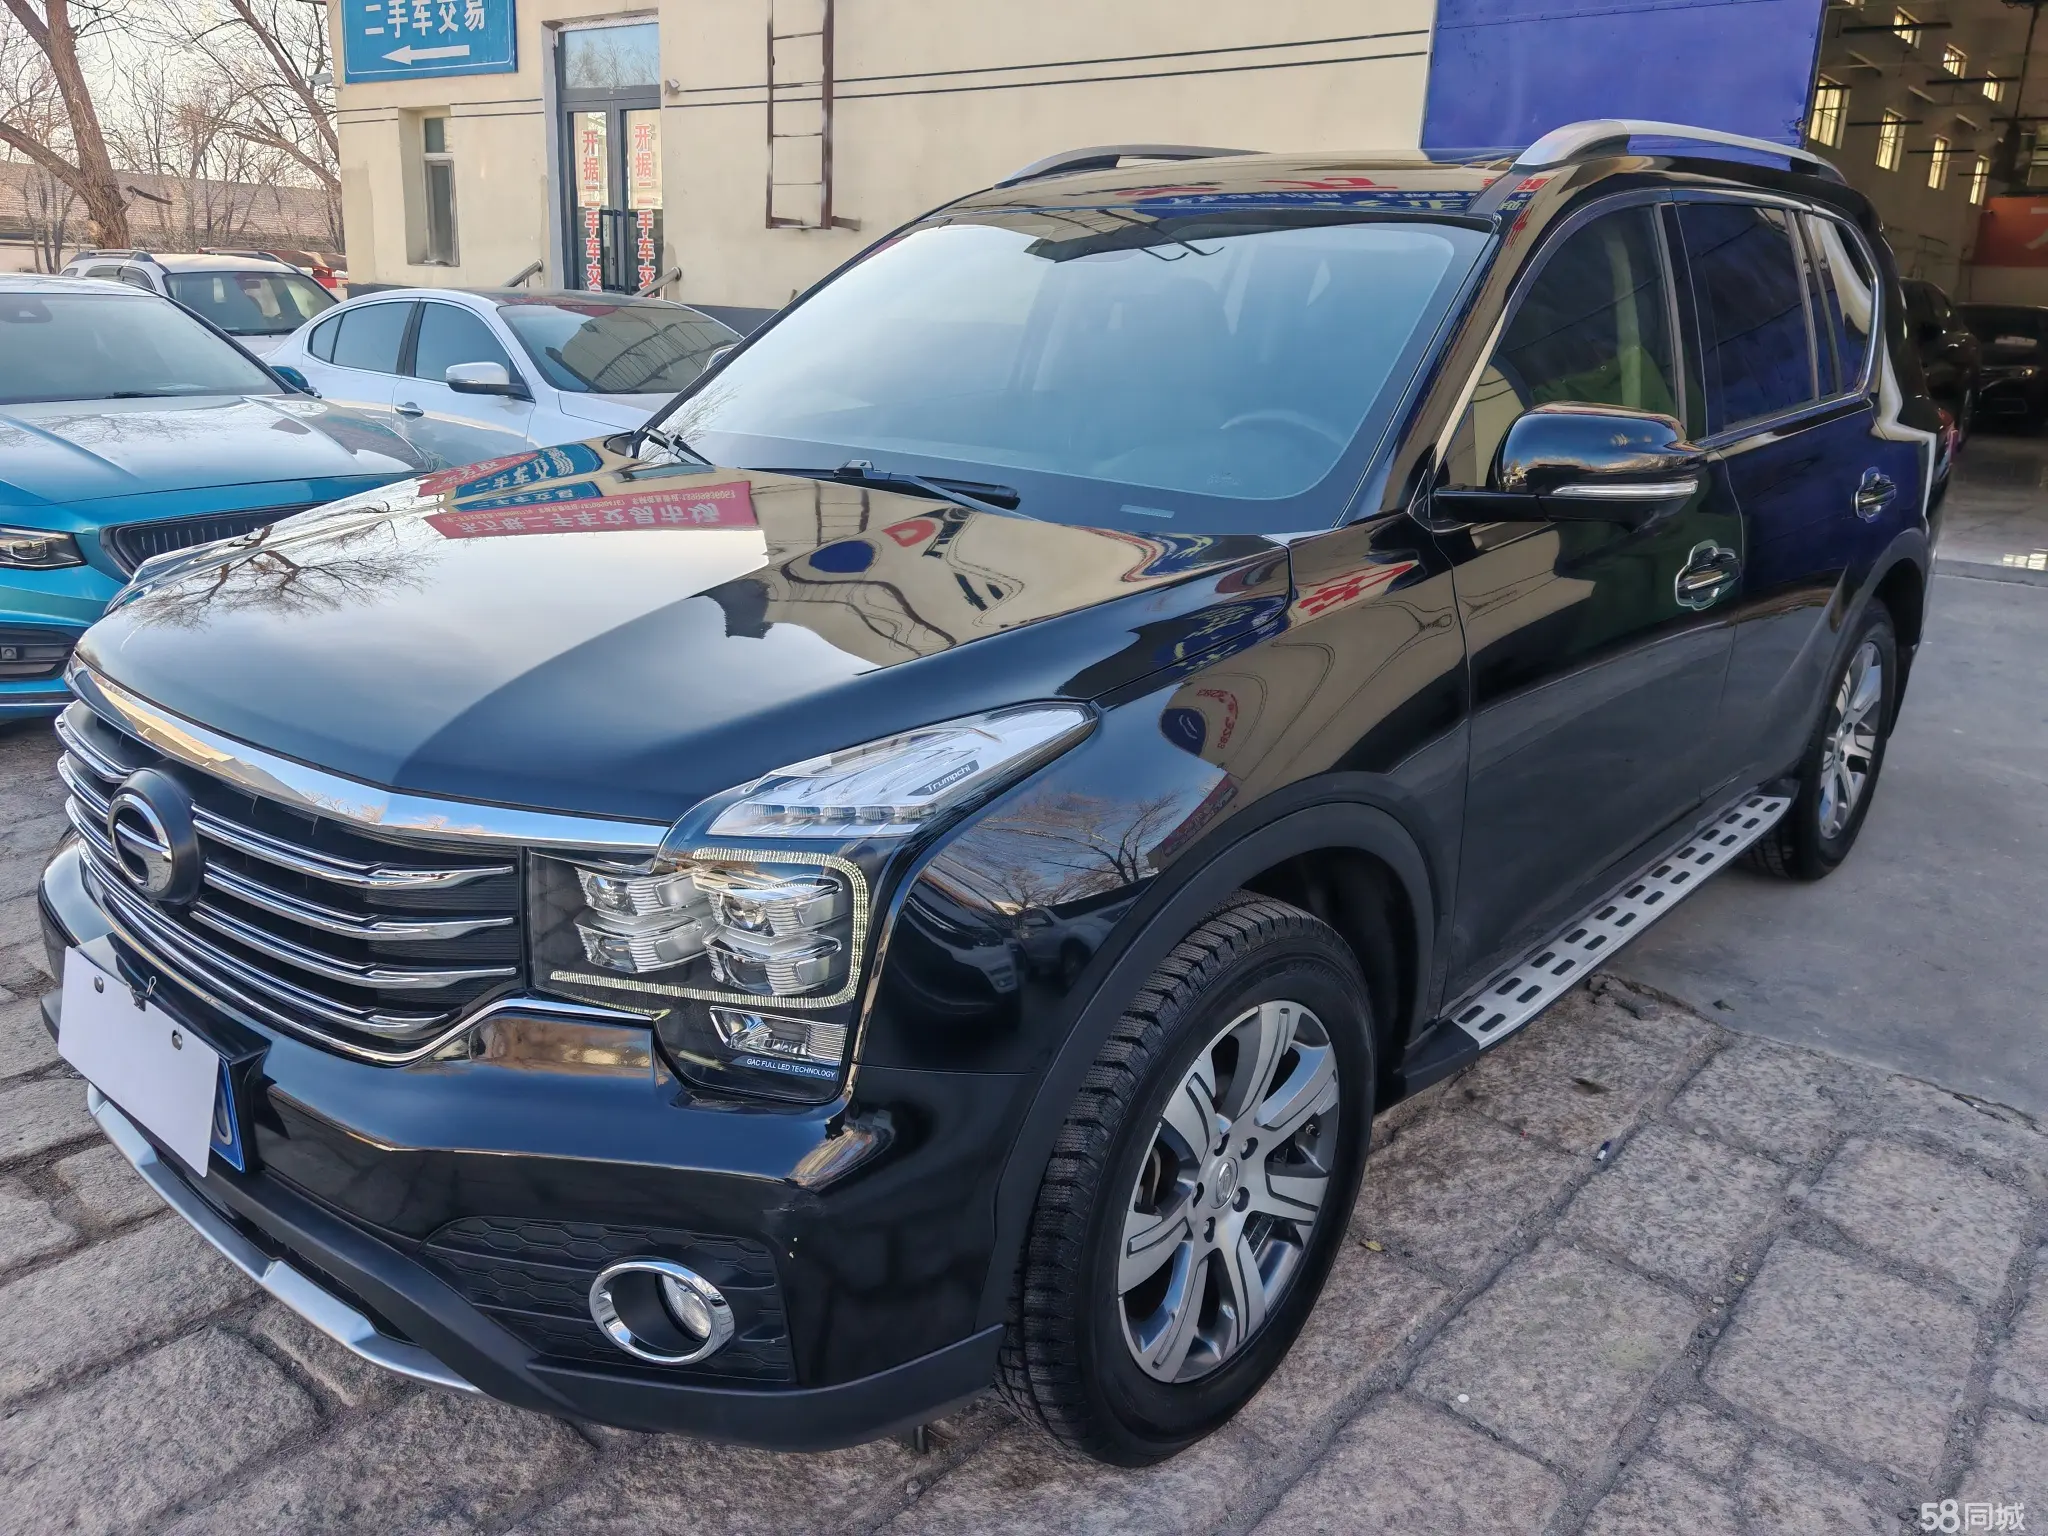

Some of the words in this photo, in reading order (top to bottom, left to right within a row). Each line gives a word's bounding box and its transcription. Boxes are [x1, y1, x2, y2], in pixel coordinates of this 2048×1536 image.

[365, 0, 485, 38] 二手车交易
[582, 129, 603, 294] 开据二手车交
[634, 123, 657, 297] 开据二手车交
[925, 765, 970, 792] Trumpchi
[747, 1058, 760, 1066] GAC
[761, 1061, 776, 1069] FULL
[778, 1063, 790, 1071] LED
[792, 1065, 836, 1078] TECHNOLOGY
